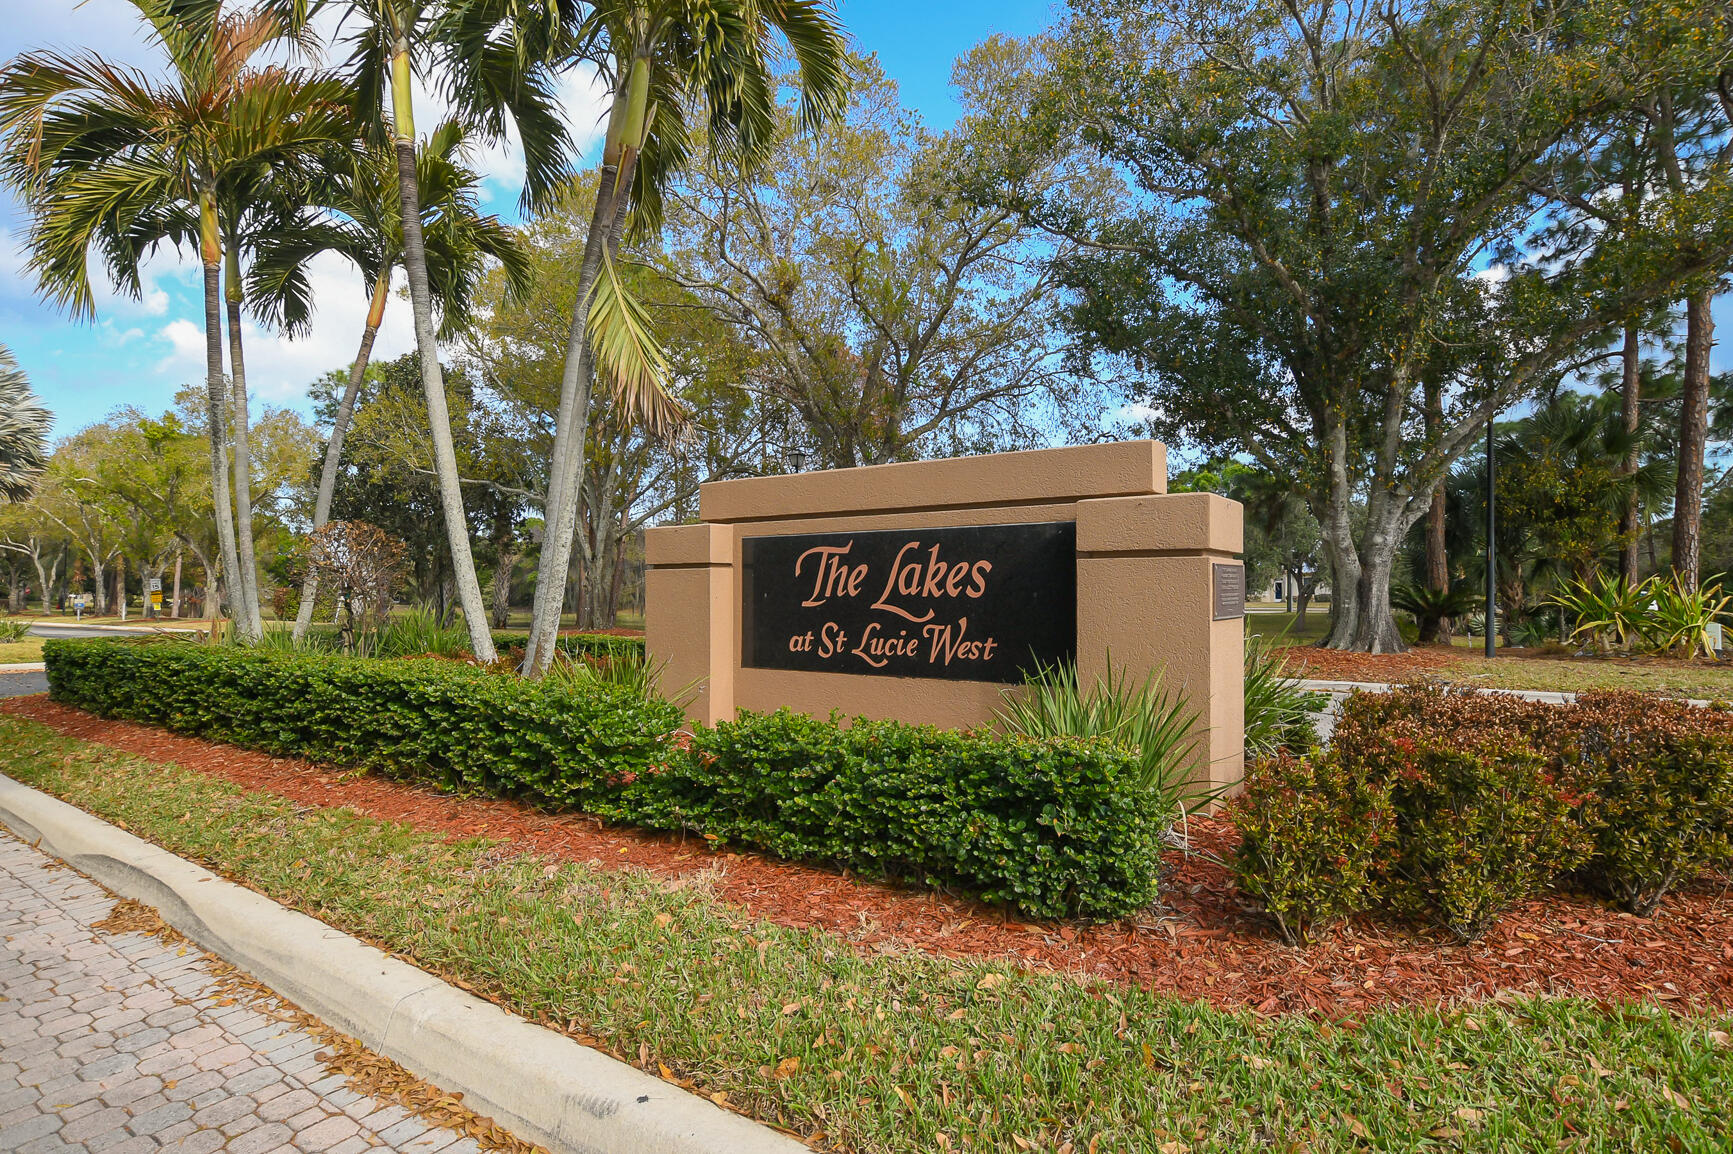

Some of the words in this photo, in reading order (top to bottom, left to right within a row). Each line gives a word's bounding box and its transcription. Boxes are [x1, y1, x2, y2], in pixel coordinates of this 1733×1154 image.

[795, 540, 869, 608] The
[870, 541, 993, 623] Lakes
[789, 631, 814, 652] at
[817, 621, 848, 659] St
[851, 622, 919, 668] Lucie
[922, 616, 998, 666] West
